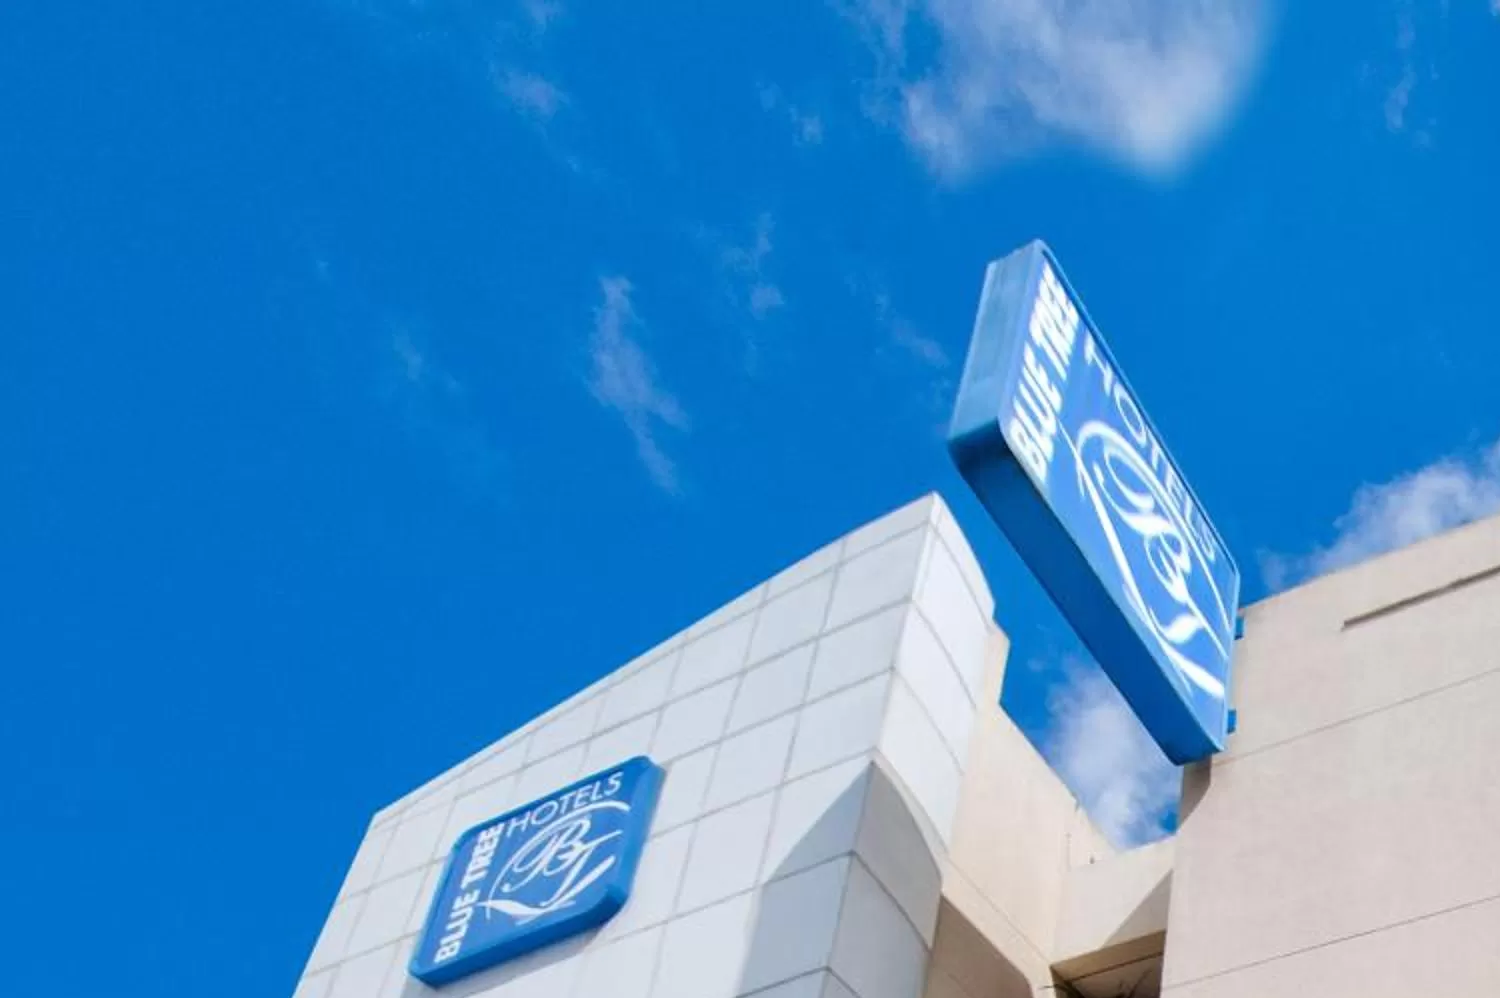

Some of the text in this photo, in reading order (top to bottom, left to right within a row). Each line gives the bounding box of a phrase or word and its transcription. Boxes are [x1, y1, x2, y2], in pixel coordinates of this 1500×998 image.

[1009, 262, 1079, 484] BLUE TREE
[1084, 332, 1216, 562] HOTELS
[434, 823, 505, 964] BLUE TREE
[506, 772, 624, 837] HOTELS
